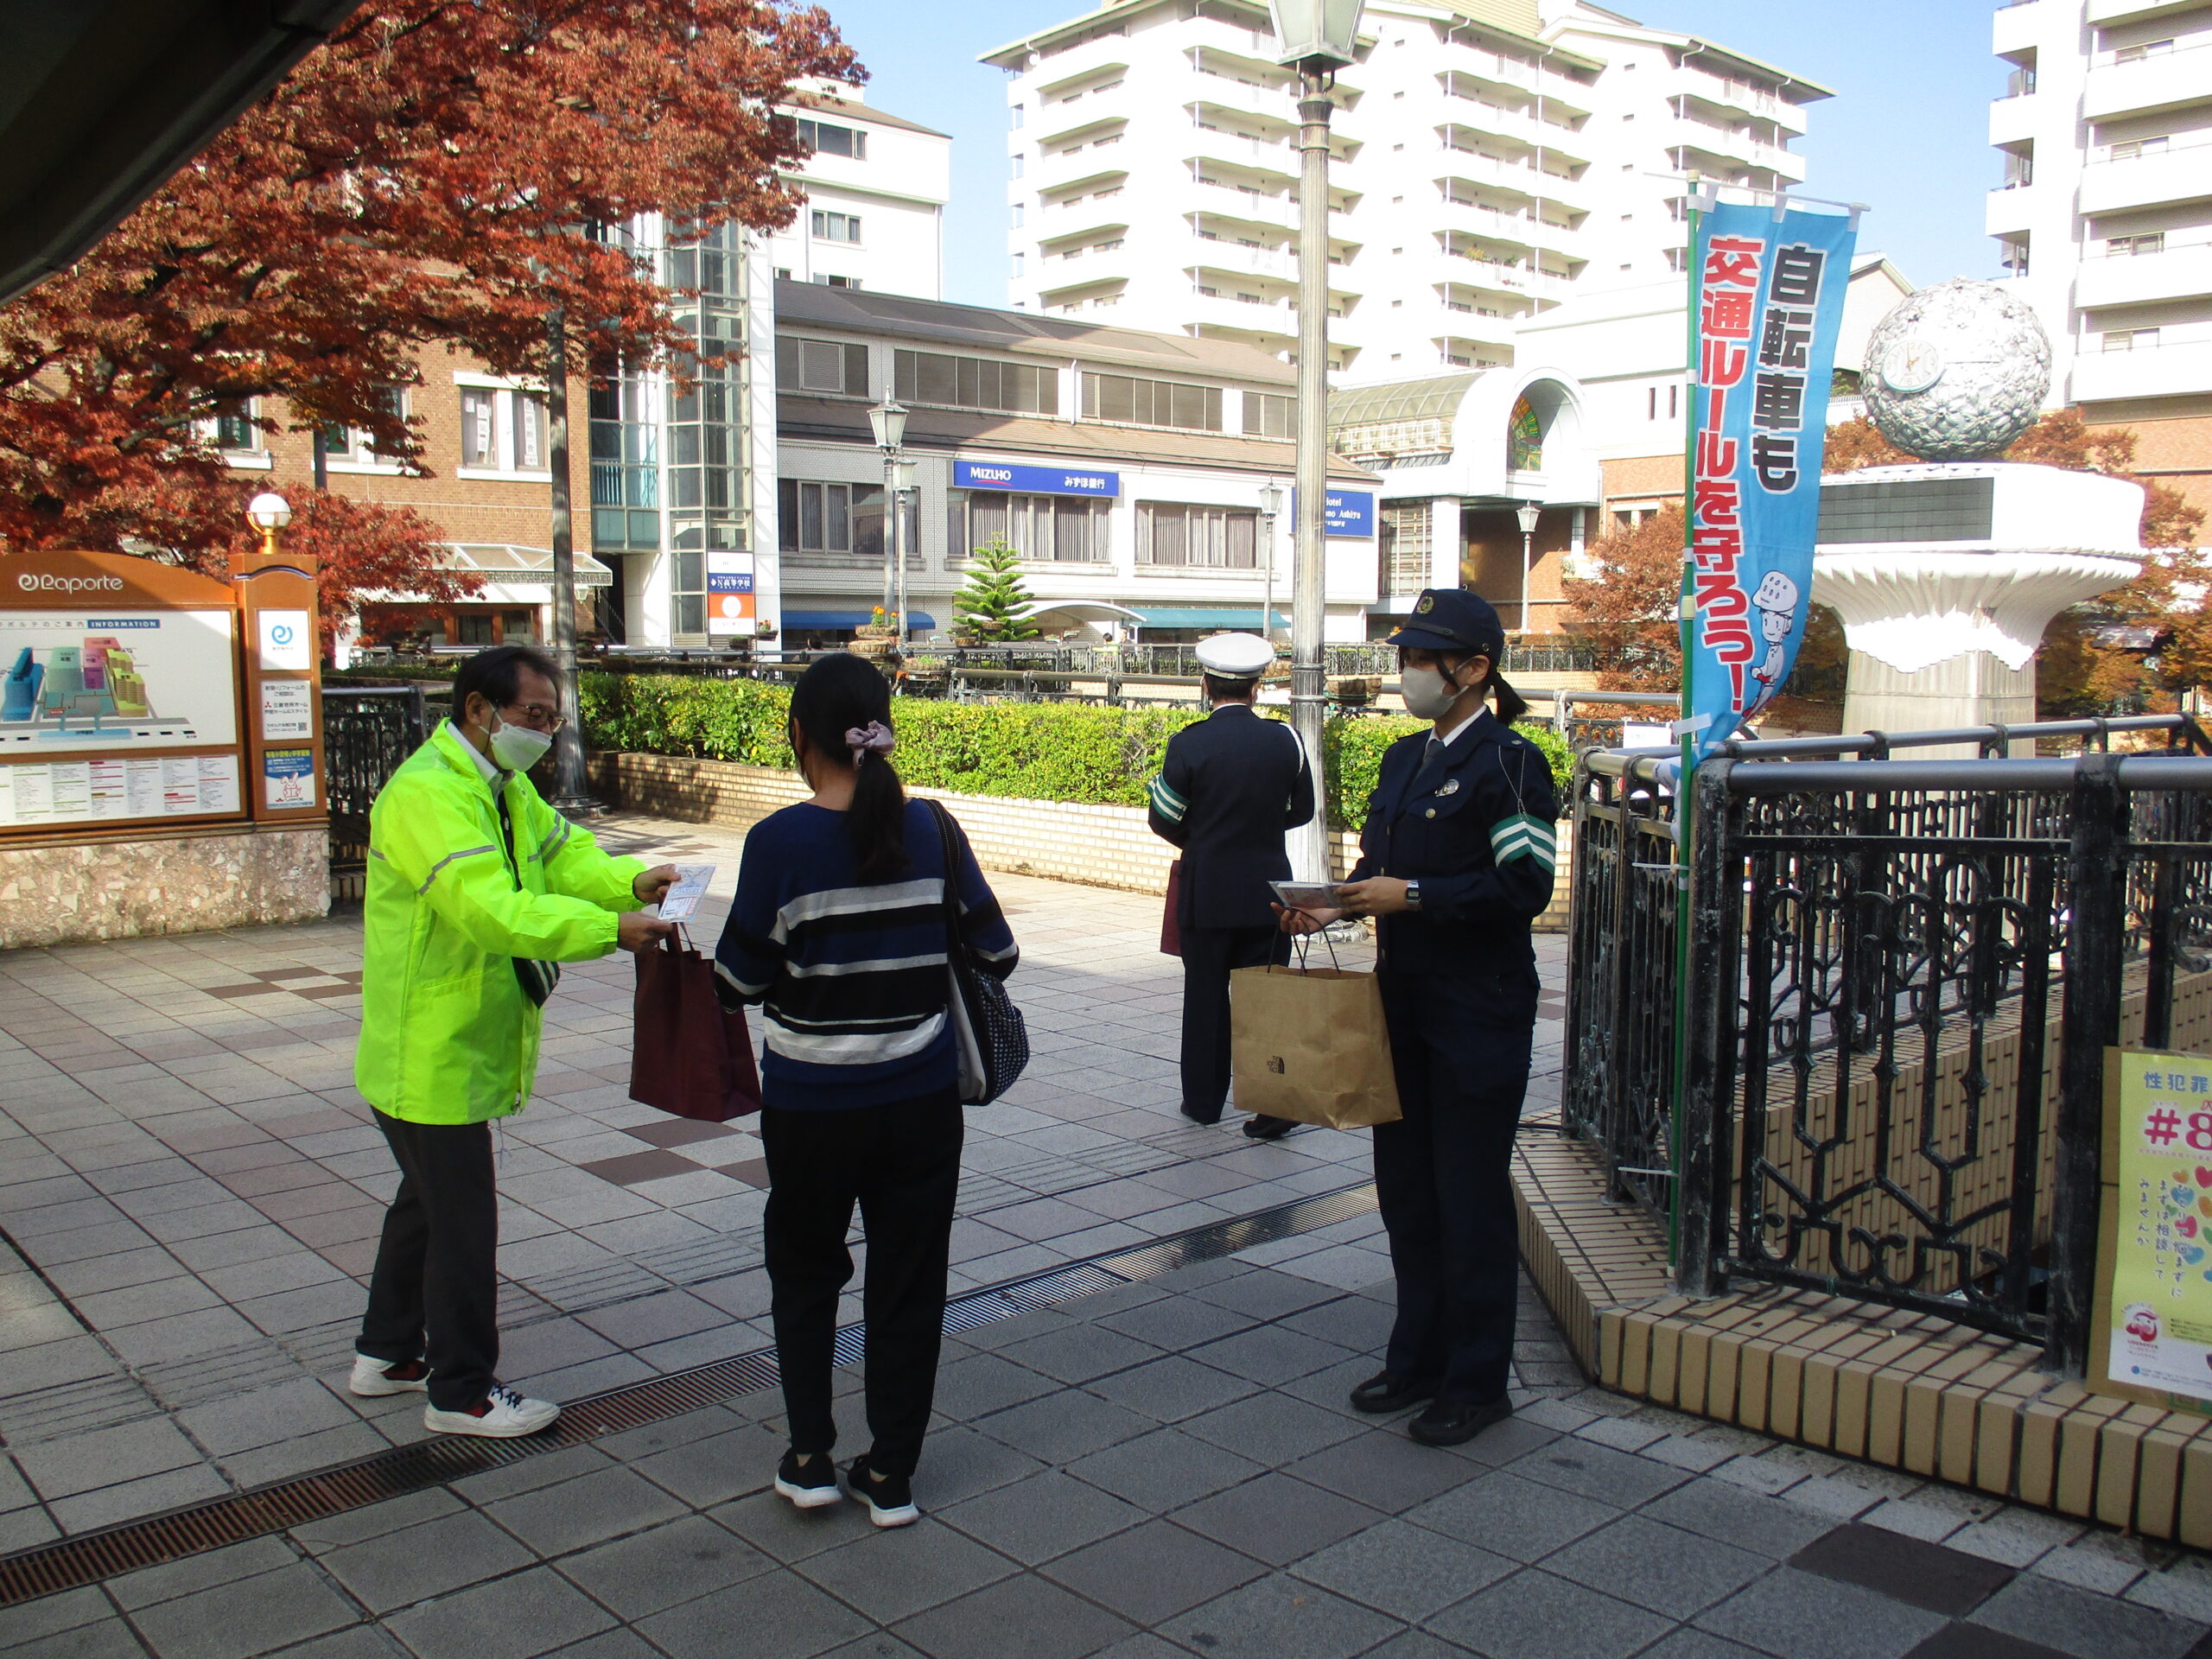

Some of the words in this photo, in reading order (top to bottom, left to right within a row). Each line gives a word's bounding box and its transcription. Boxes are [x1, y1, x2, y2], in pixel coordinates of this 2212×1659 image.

[1751, 244, 1826, 493] 自転車も
[970, 467, 1012, 481] MIZUHO
[1065, 476, 1105, 490] みずほ銀行
[1338, 510, 1361, 520] Ashiya
[2144, 1071, 2209, 1094] 性犯罪
